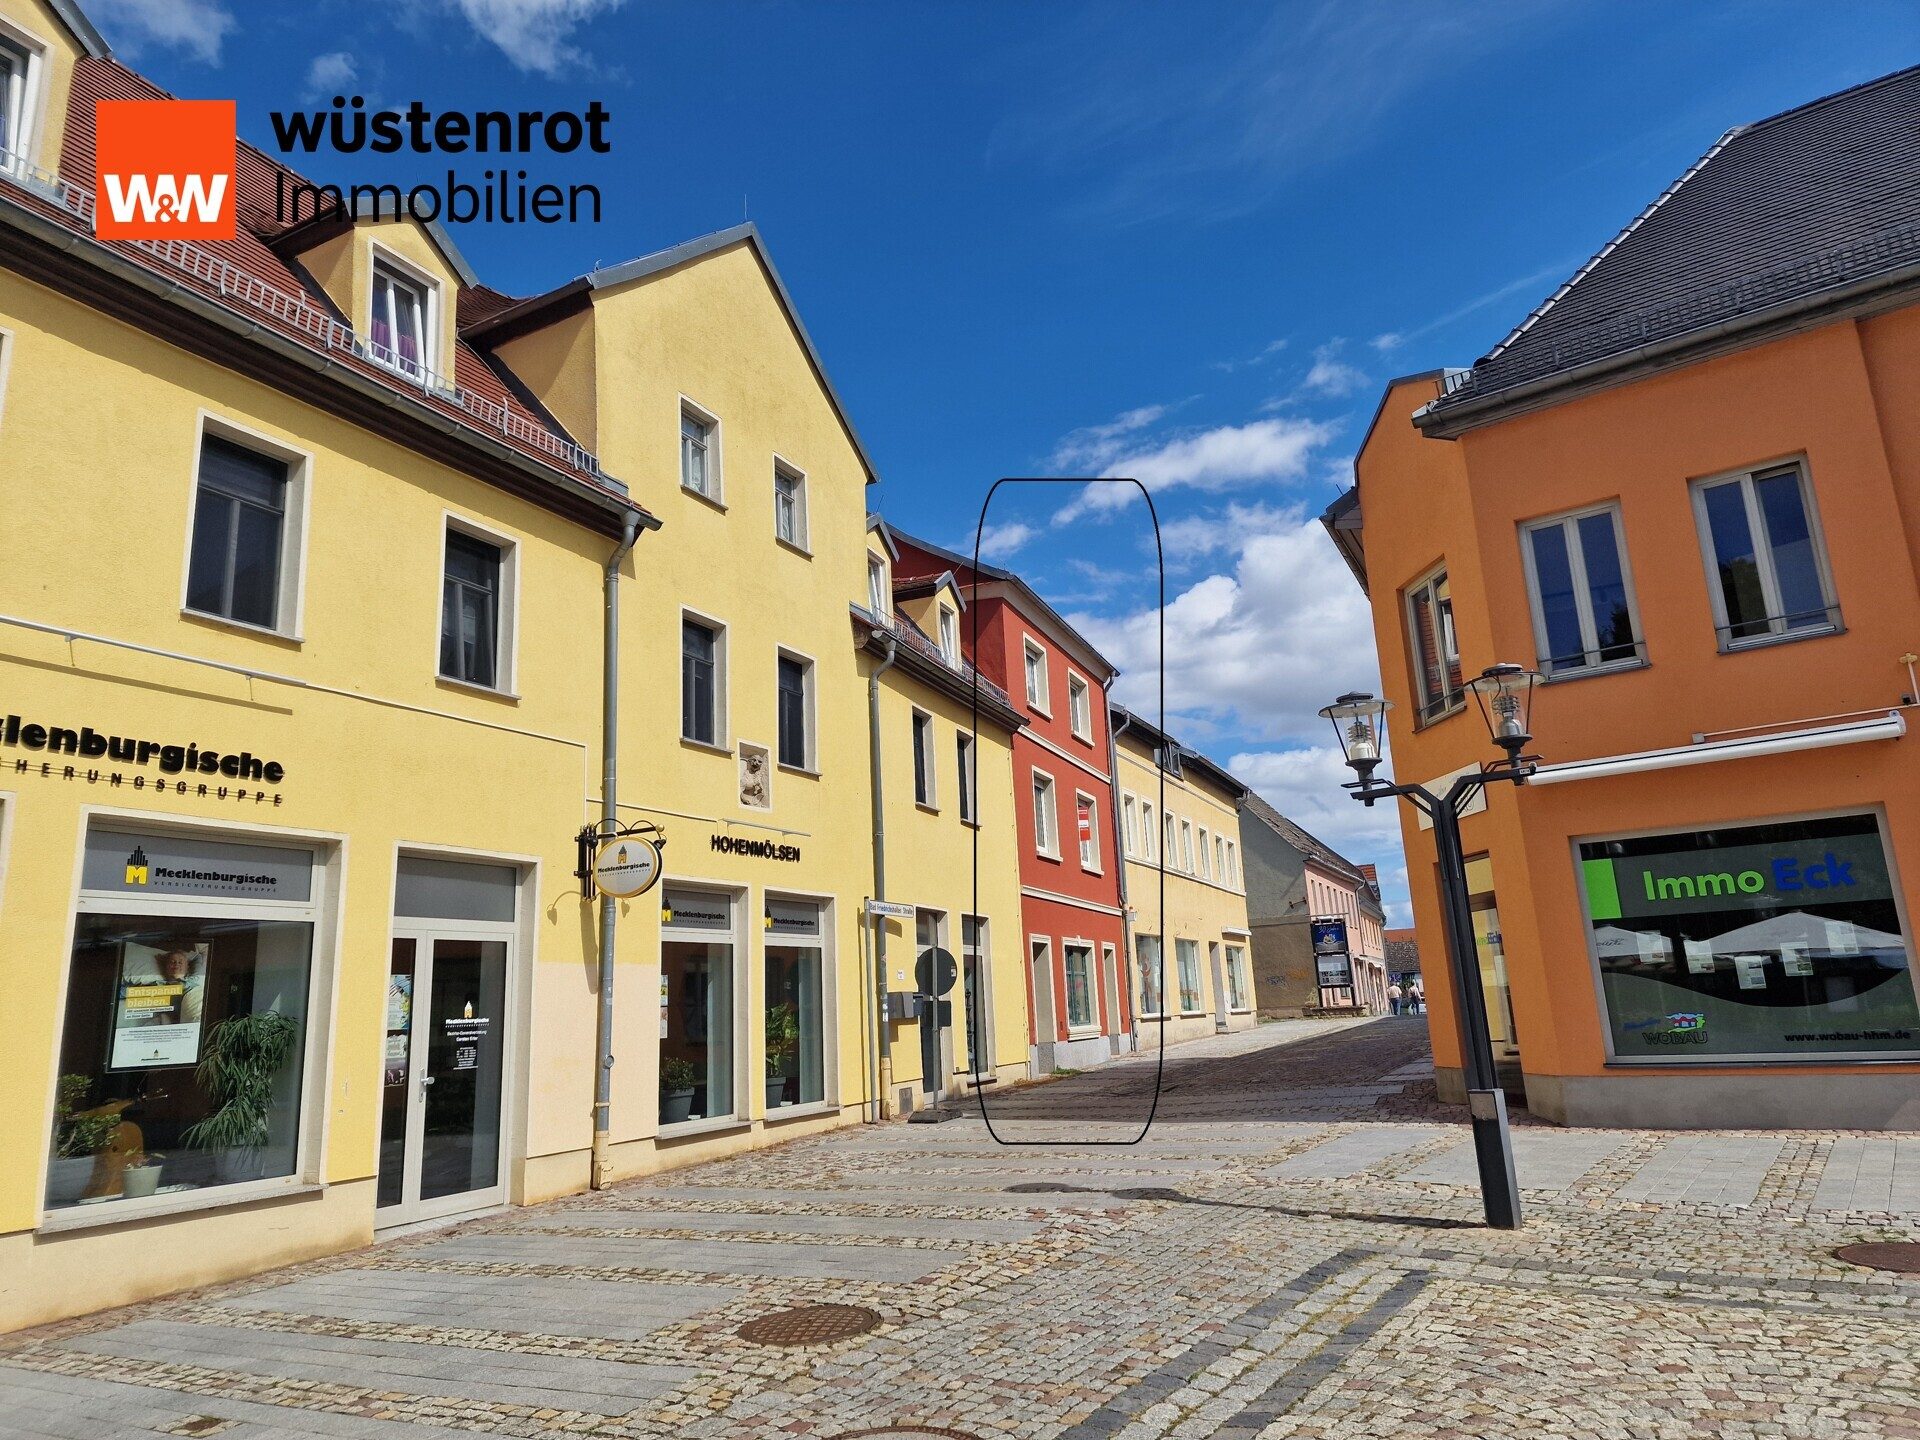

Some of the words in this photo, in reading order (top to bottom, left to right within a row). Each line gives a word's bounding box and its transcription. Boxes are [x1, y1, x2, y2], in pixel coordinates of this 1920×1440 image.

[0, 714, 285, 782] lenburgische
[0, 757, 284, 807] HERUNGSGRUPPE
[710, 834, 801, 863] HOHENMÖLSEN
[597, 862, 650, 874] Mecklenburgische
[155, 867, 278, 886] Mecklenburgische
[1643, 870, 1765, 901] Immo
[1771, 852, 1857, 891] Eck
[673, 910, 726, 921] Mecklenburgische
[773, 917, 815, 927] Mecklenburgische
[1642, 1031, 1708, 1045] WOBAU
[1784, 1030, 1911, 1042] www.wobau-hhm.de
